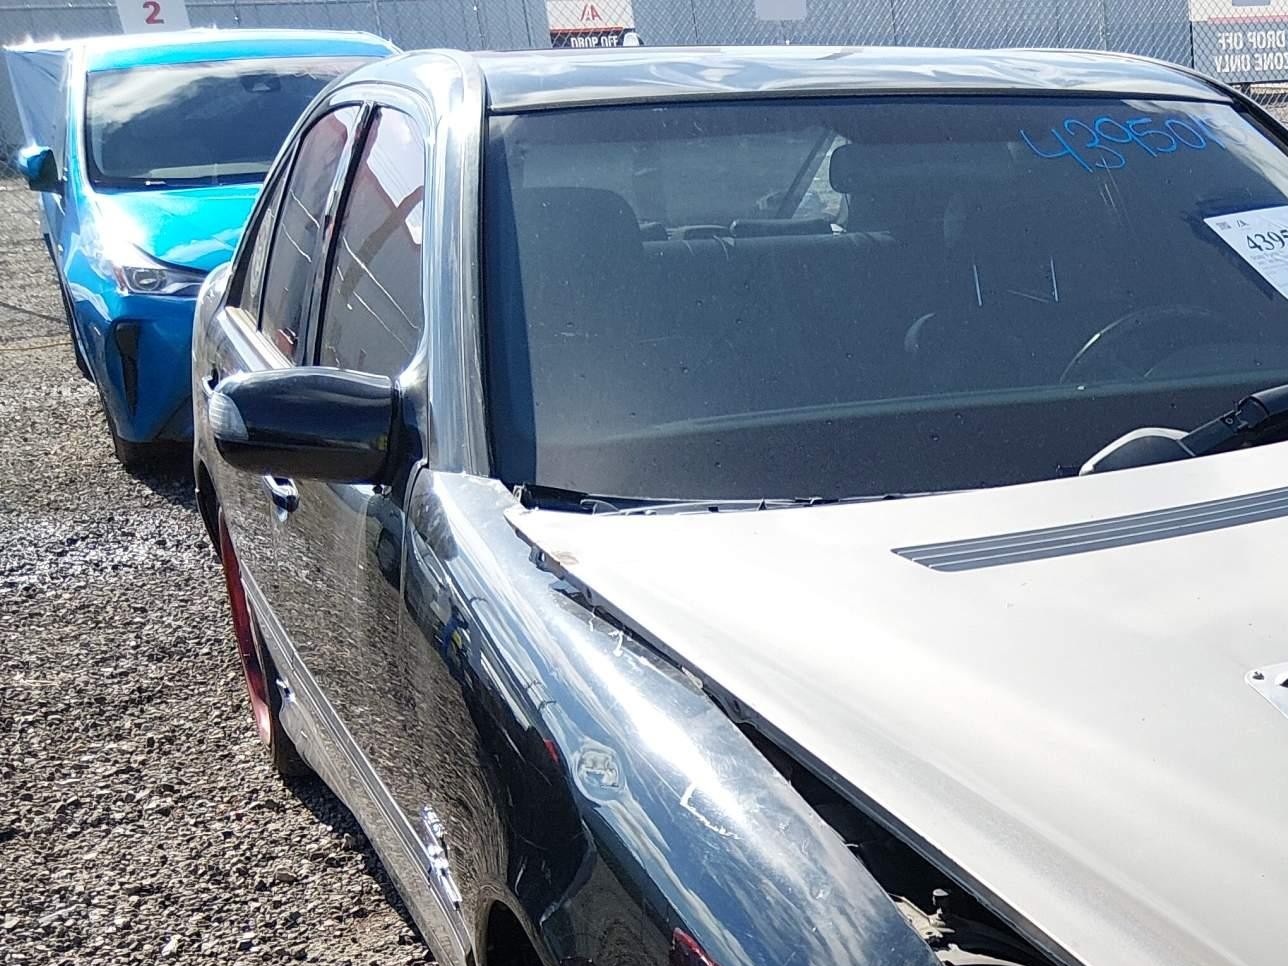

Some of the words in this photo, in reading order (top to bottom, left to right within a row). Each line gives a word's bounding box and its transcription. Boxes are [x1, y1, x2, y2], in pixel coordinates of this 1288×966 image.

[142, 1, 165, 25] 2
[570, 35, 598, 48] DROP
[600, 35, 619, 48] OFF
